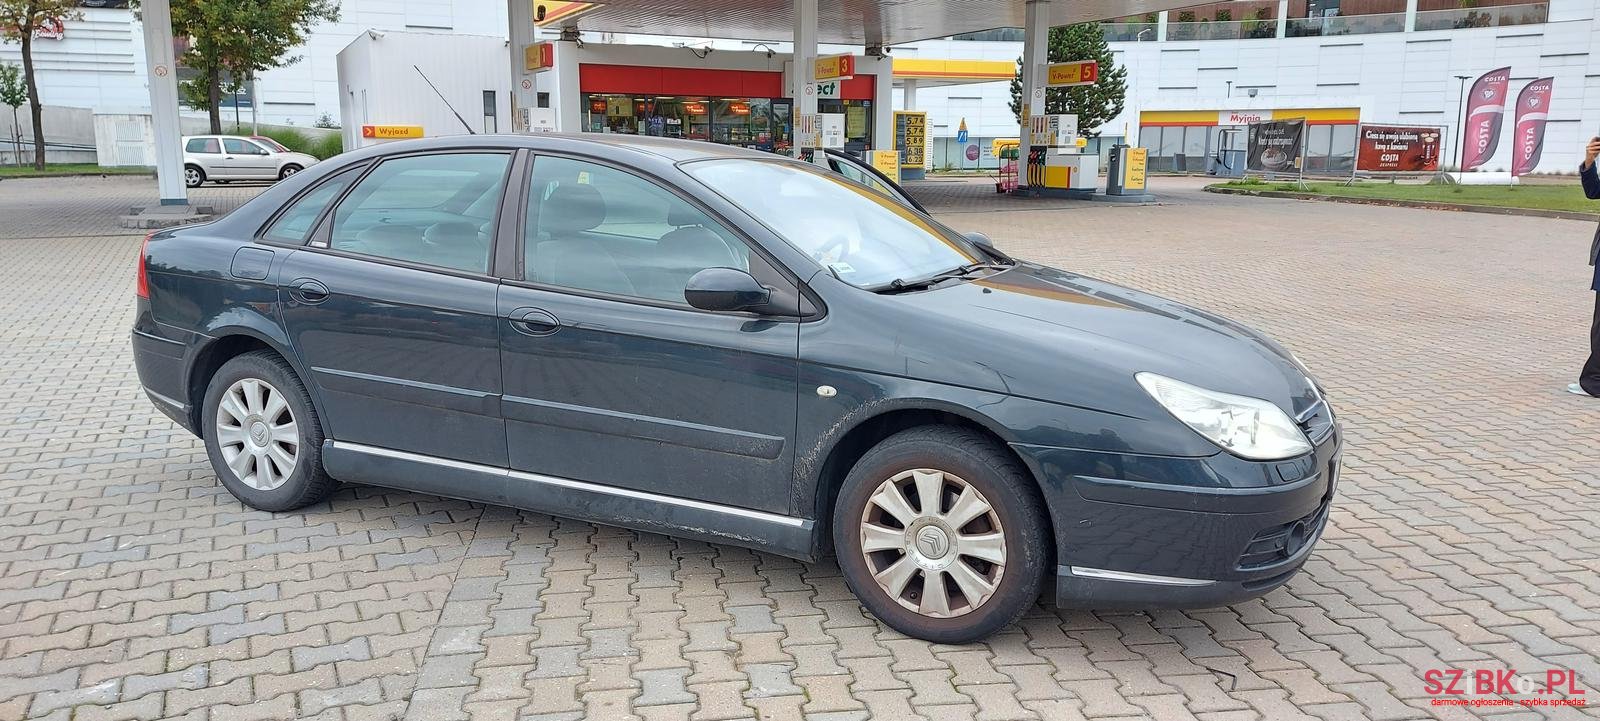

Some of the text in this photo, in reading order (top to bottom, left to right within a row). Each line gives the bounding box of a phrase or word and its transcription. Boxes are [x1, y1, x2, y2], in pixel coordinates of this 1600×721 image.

[841, 58, 848, 72] 3
[1083, 66, 1091, 79] 5
[817, 82, 835, 95] ect
[1230, 114, 1260, 123] Myjnia
[379, 128, 409, 136] Wyjazd
[1478, 120, 1490, 153] COSTA
[1524, 127, 1536, 160] COSTA
[1381, 154, 1399, 162] COSTA
